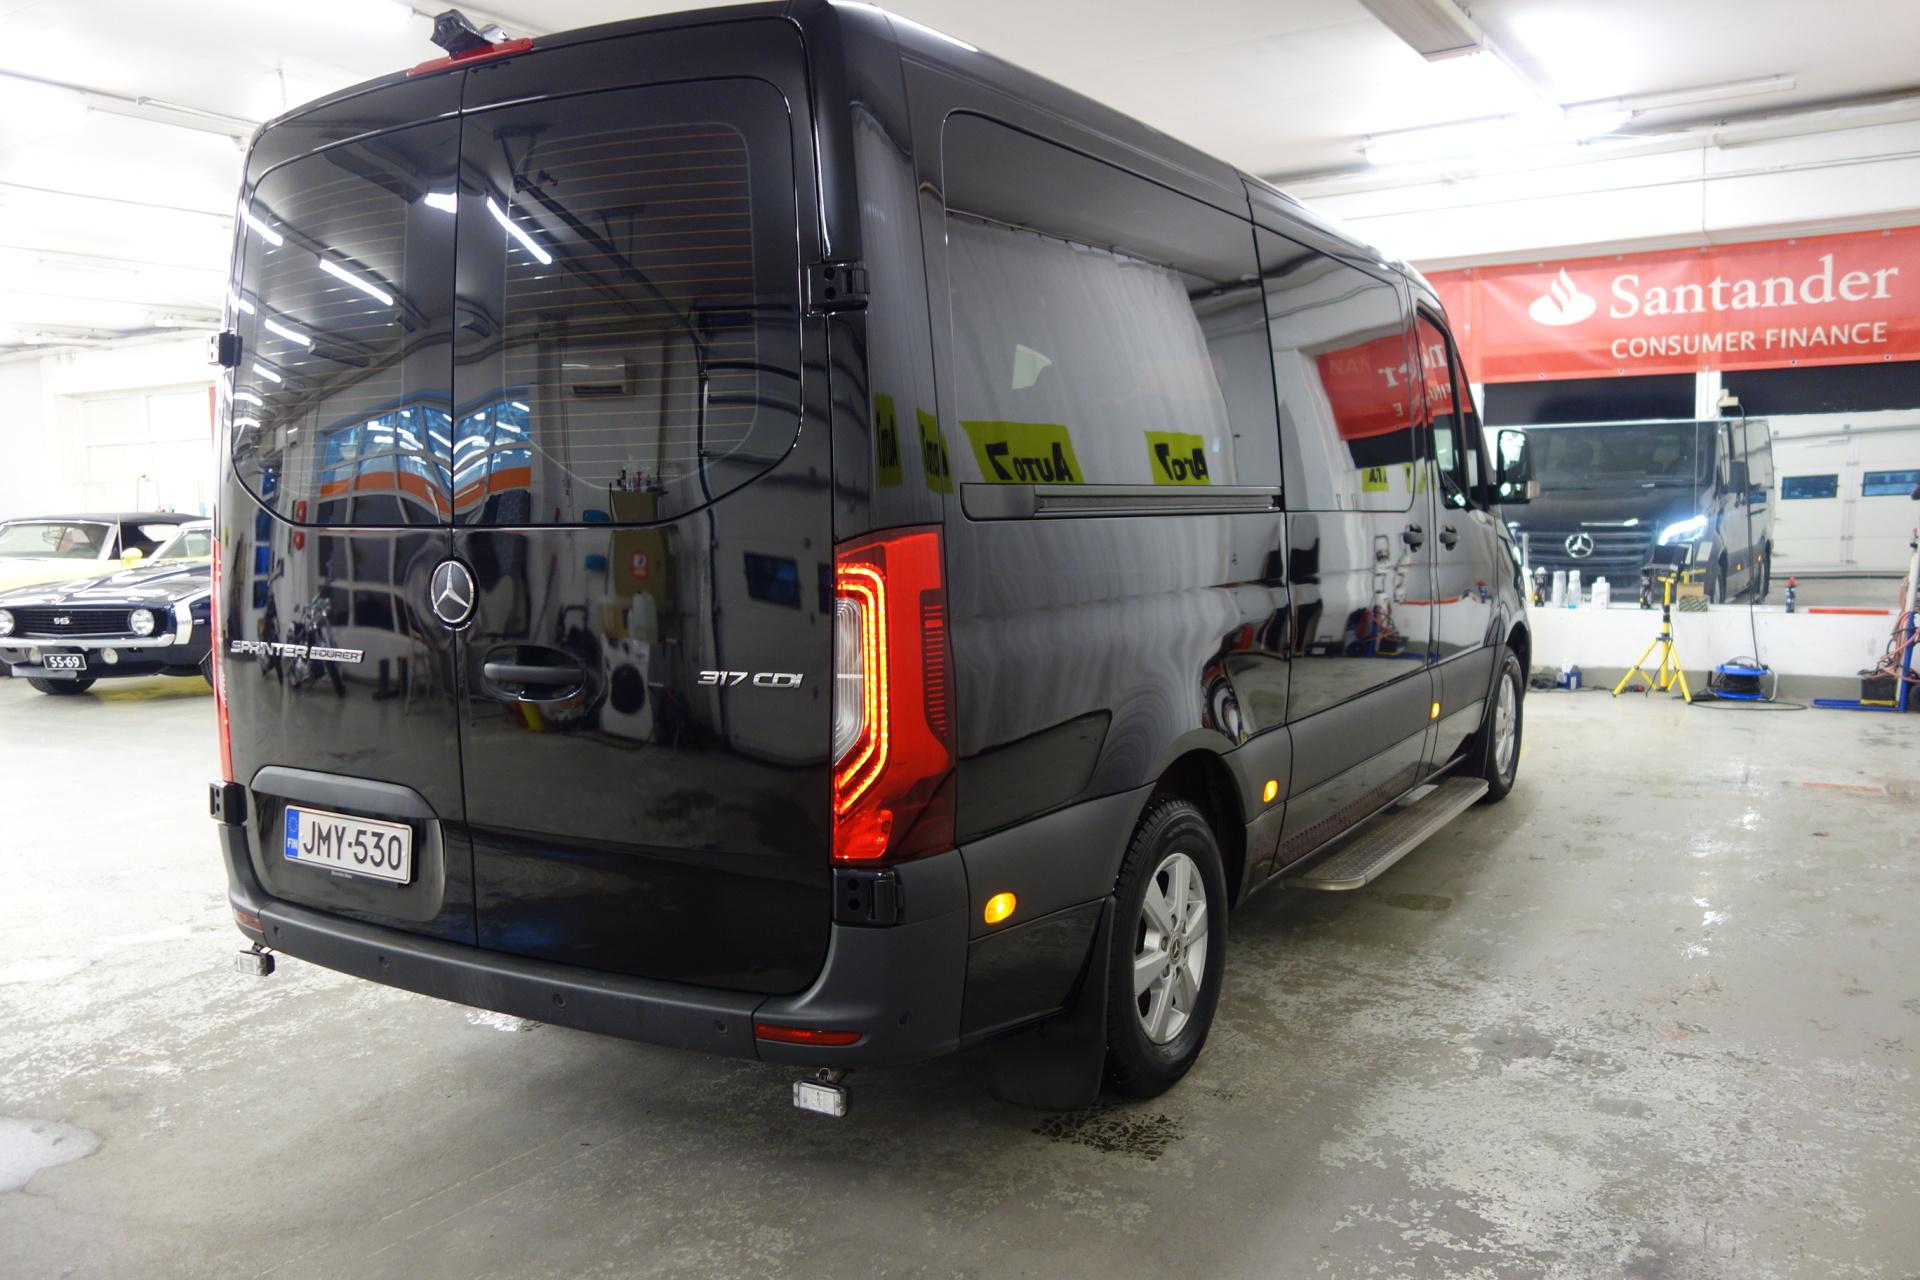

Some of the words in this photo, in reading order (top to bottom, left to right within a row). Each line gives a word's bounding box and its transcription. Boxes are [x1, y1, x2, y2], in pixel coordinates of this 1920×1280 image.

[1610, 253, 1898, 320] Santander
[1611, 331, 1756, 359] CONSUMER
[1765, 321, 1888, 350] FINANCE
[49, 656, 80, 668] SS-69
[230, 640, 308, 659] SPRINTER
[698, 671, 748, 686] 317
[753, 672, 803, 689] CDI
[303, 820, 401, 871] JMY-530
